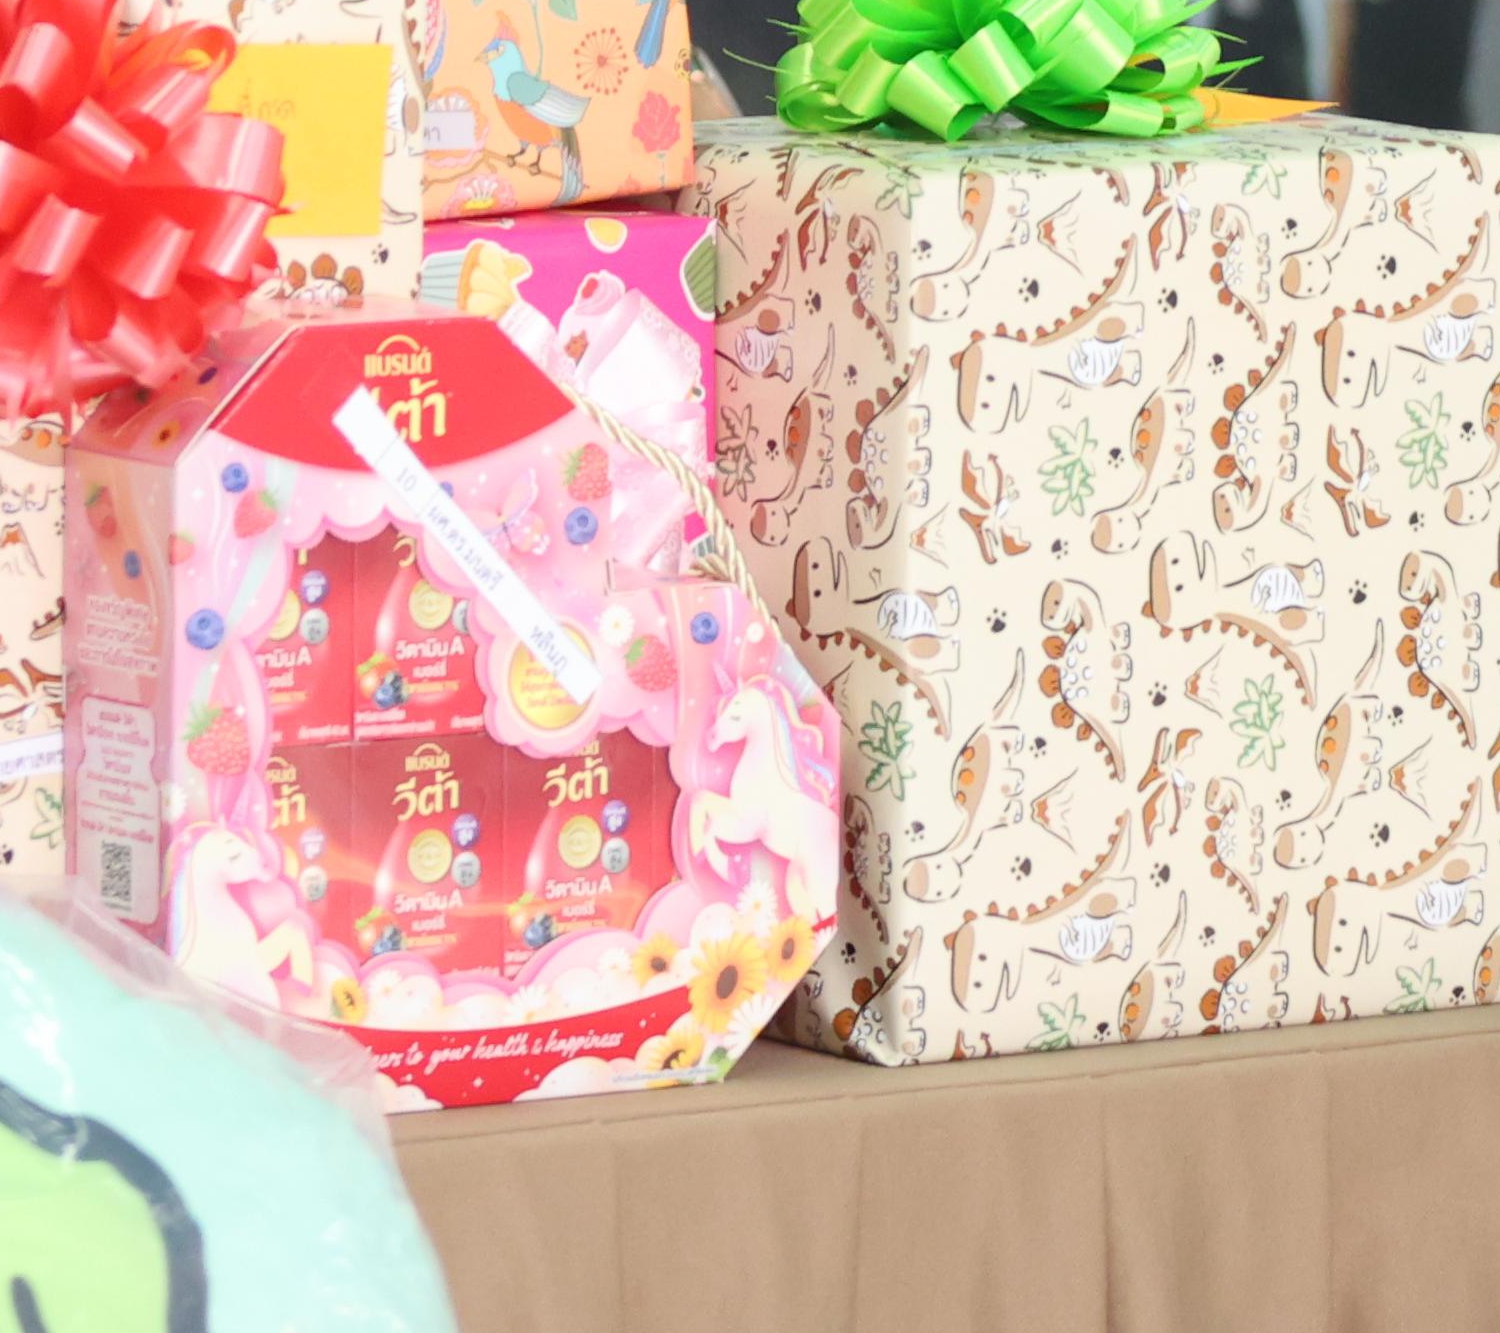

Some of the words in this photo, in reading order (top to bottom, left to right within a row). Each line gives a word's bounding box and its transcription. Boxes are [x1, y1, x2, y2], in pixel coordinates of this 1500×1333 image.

[363, 345, 433, 378] แบรนด์
[396, 468, 418, 491] 10
[391, 770, 460, 823] วีต้า
[541, 756, 609, 809] วีต้า
[407, 1042, 424, 1067] to
[423, 1045, 472, 1075] your
[472, 1032, 530, 1060] health
[544, 1028, 625, 1058] happiness
